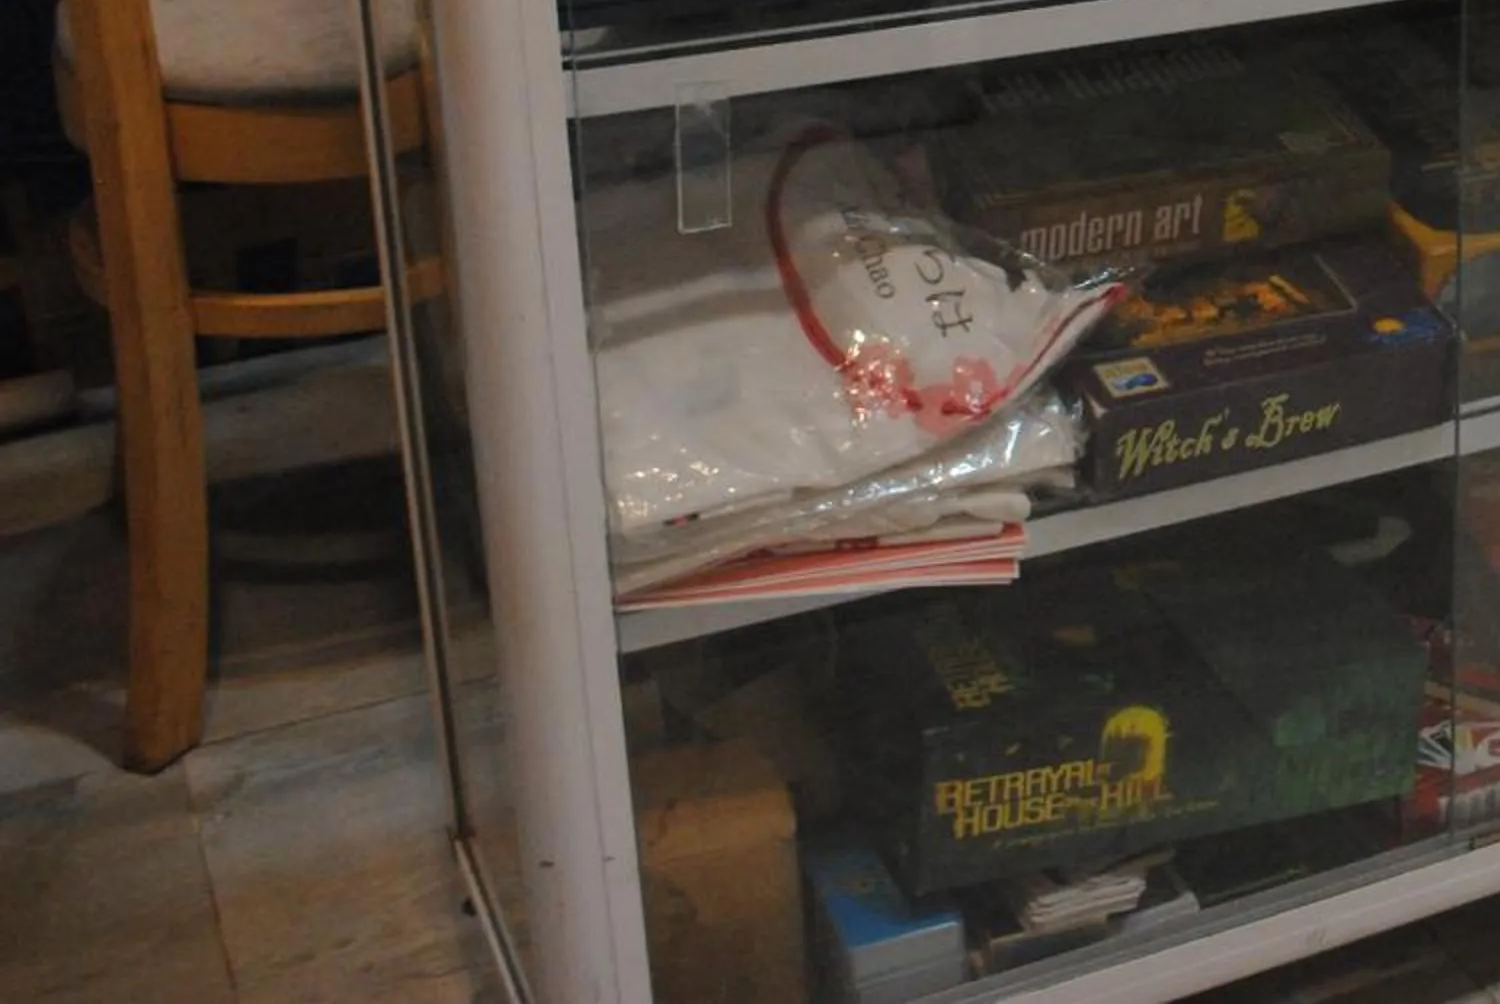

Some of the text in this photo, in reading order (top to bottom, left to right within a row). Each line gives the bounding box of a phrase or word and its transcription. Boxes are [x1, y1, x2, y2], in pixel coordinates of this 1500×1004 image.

[1019, 193, 1205, 262] modern art
[1116, 393, 1342, 481] Witch's Brew
[935, 757, 1099, 815] BETRAYAL
[953, 795, 1066, 841] HOUSE
